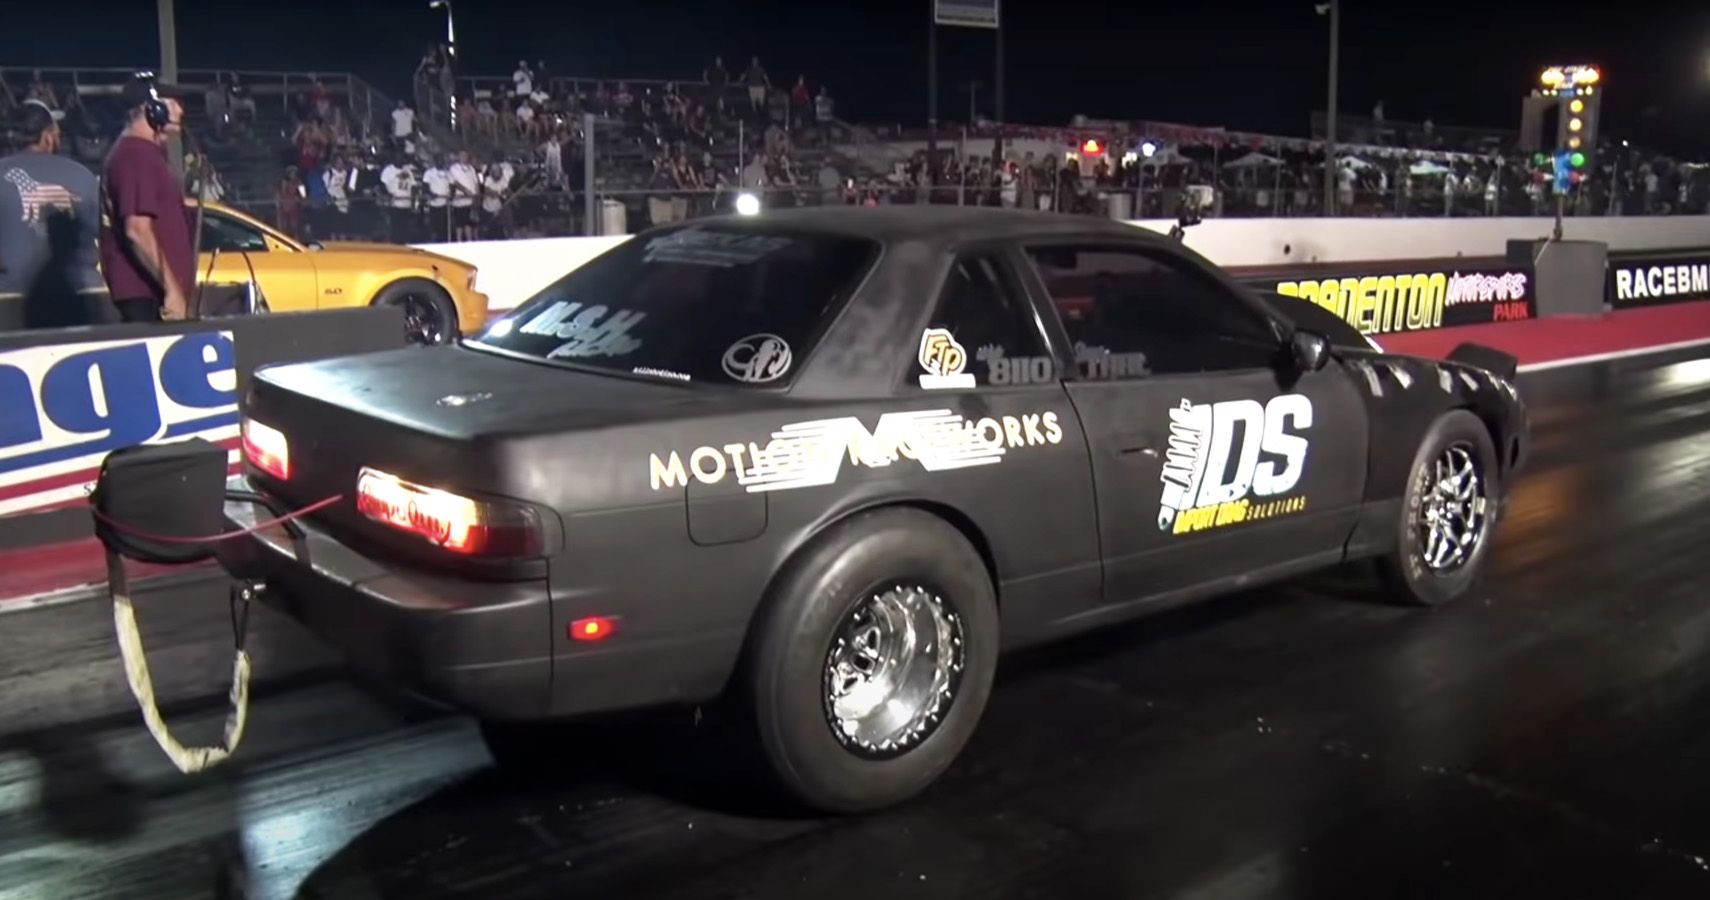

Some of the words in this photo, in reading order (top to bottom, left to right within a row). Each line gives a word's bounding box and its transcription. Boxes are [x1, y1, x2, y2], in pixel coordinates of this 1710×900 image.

[1616, 264, 1710, 300] RACEBM
[1277, 273, 1446, 335] ADENTON
[1493, 302, 1528, 321] PARK
[649, 437, 833, 490] MOTIO
[1246, 496, 1307, 521] SOLUTIONS
